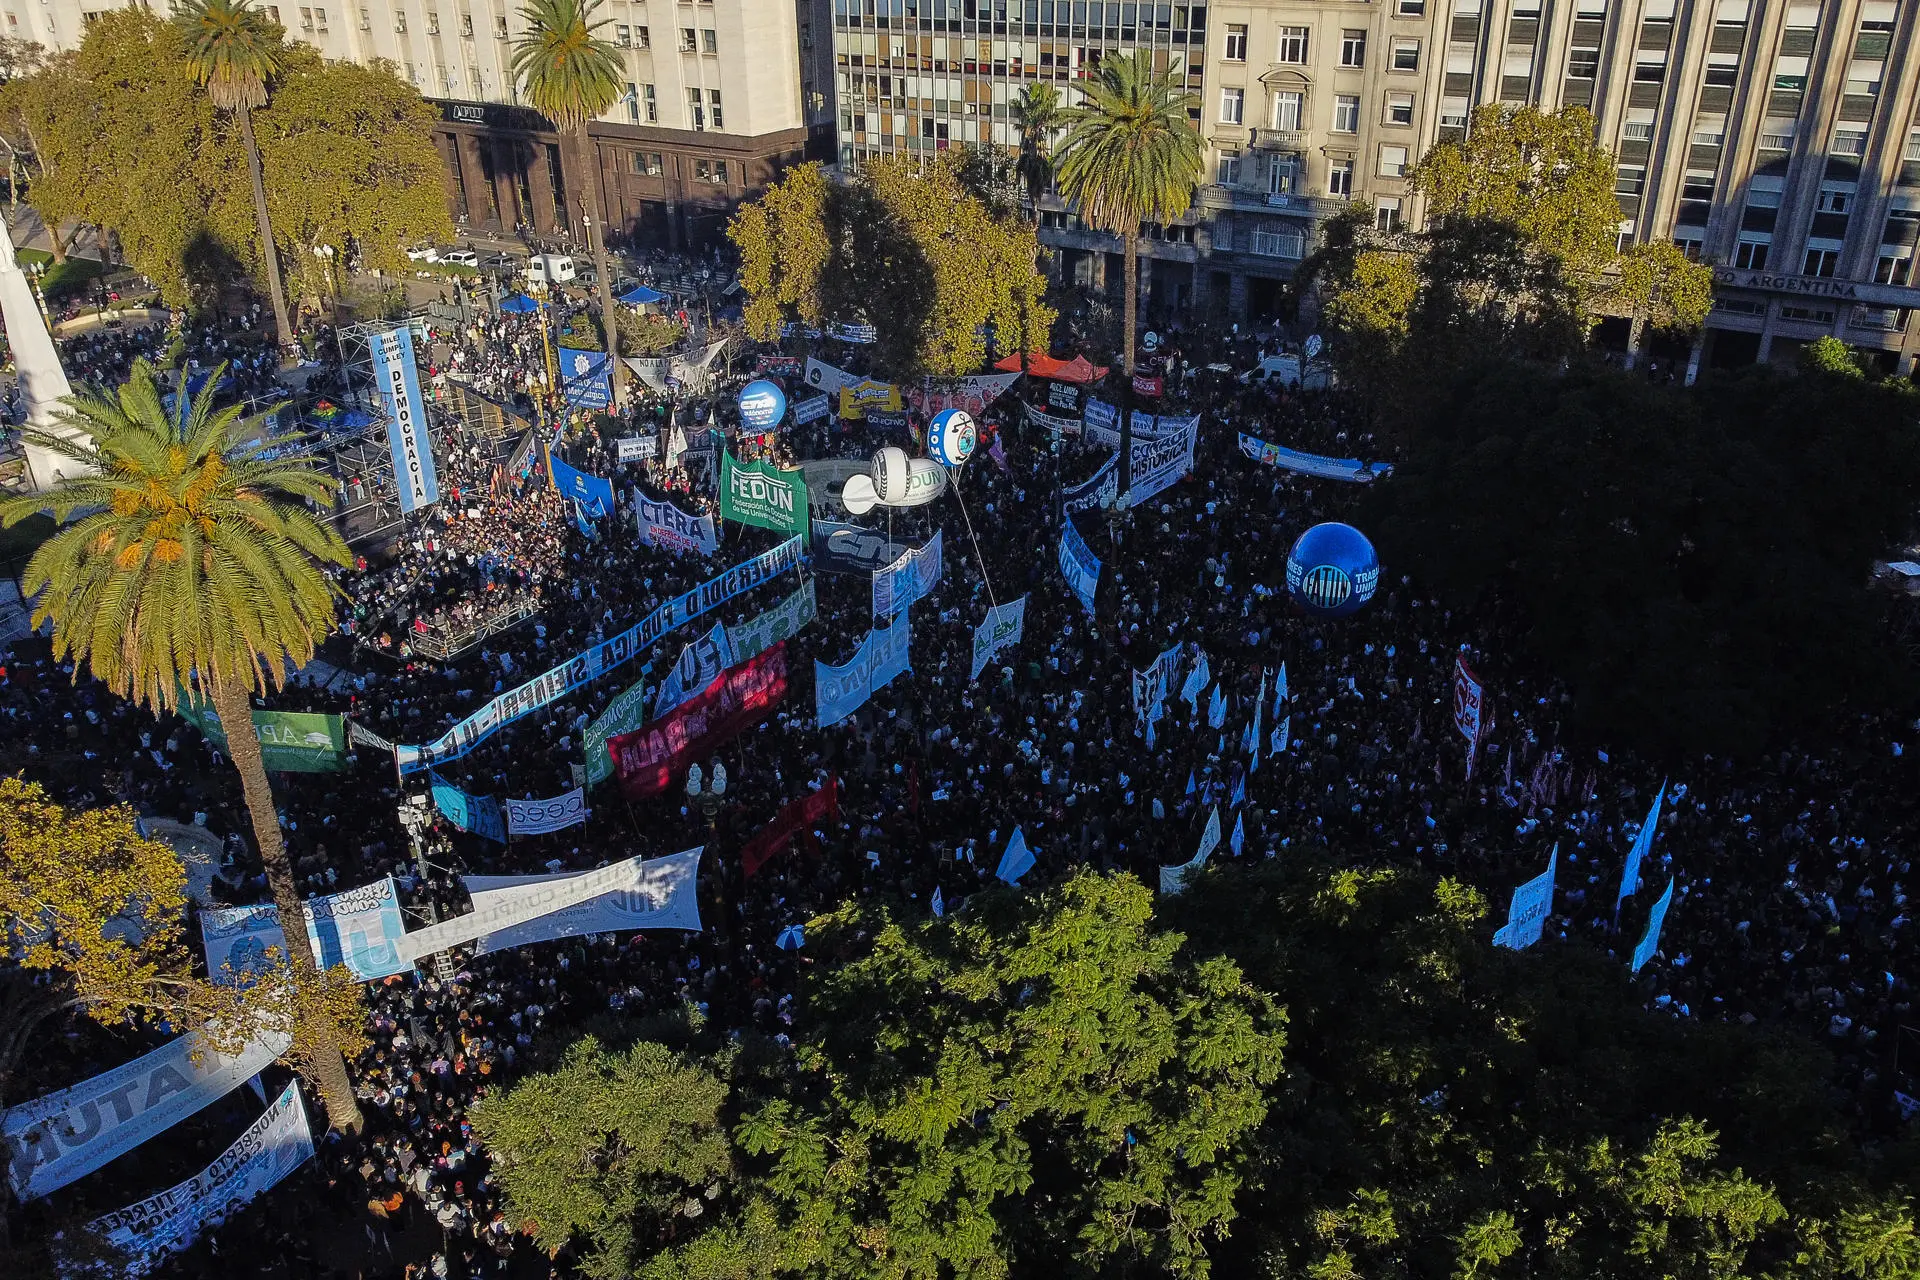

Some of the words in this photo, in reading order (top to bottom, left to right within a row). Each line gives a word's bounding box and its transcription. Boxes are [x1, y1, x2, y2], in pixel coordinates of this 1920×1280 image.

[1748, 275, 1857, 298] ARGENTINA
[380, 334, 401, 346] MILEI
[381, 356, 391, 365] LA
[392, 351, 406, 361] LEY
[391, 370, 423, 498] DEMOCRACIA
[931, 422, 944, 465] SOMU
[731, 471, 793, 511] FEDUN
[641, 499, 706, 541] CTERA
